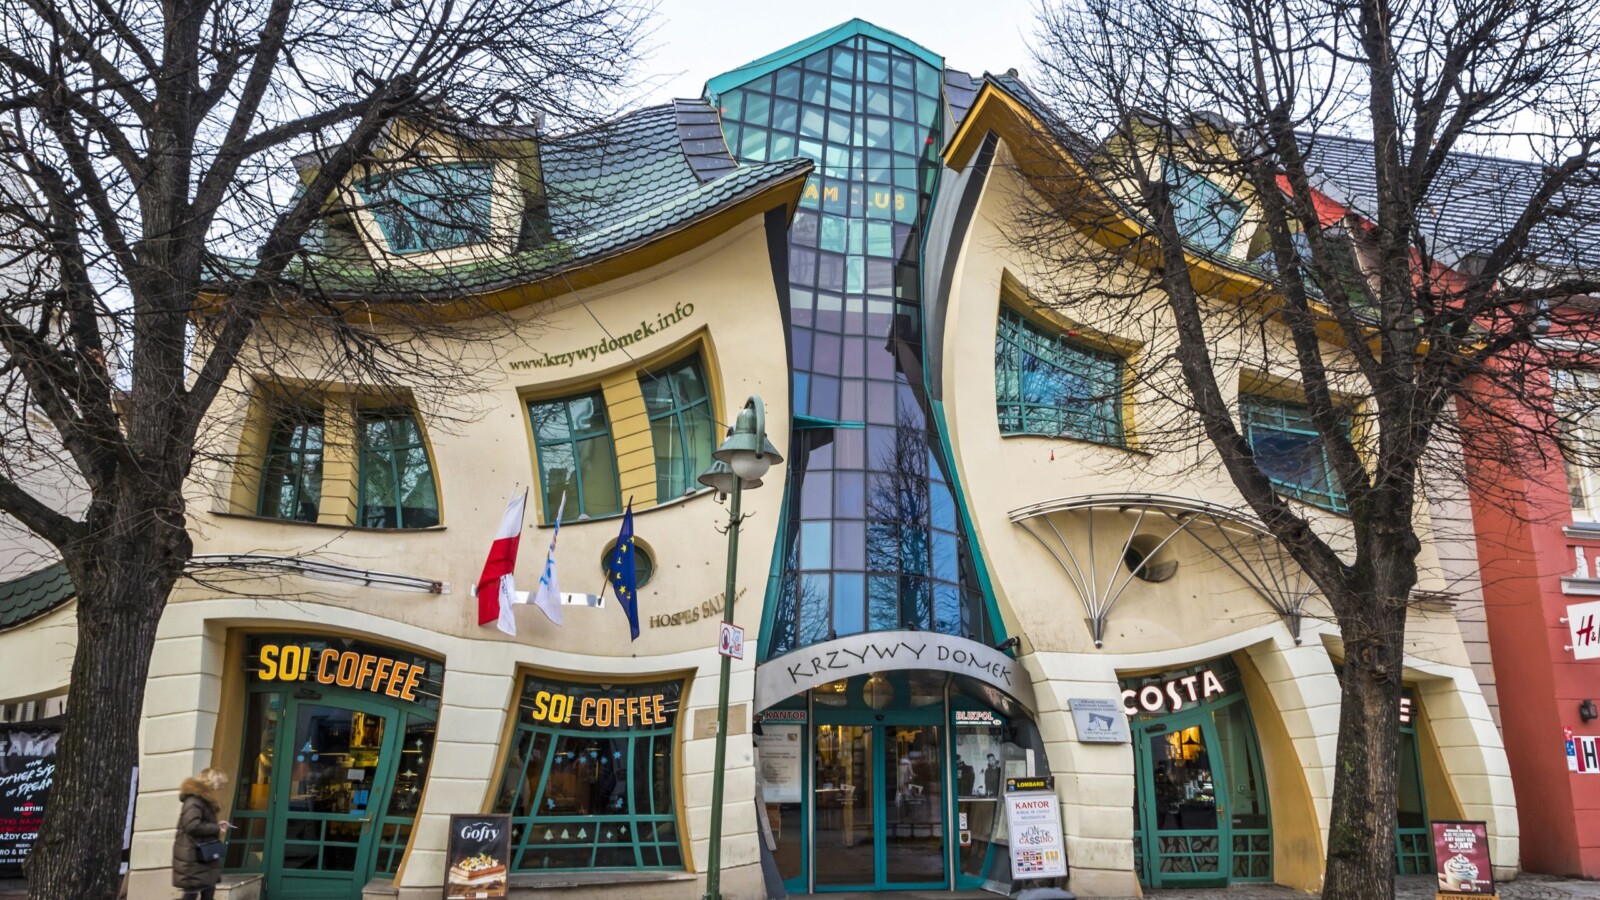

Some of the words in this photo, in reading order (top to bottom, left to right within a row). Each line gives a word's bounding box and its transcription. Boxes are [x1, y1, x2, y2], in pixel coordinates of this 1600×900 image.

[851, 188, 905, 211] UB
[509, 301, 694, 371] www.krzywydomek.info
[650, 606, 699, 629] HOSPES
[1576, 614, 1600, 646] H&
[258, 645, 312, 681] SO!
[317, 648, 425, 702] COFFEE
[787, 642, 927, 684] KRZYWY
[938, 646, 1012, 686] DOMEK
[532, 691, 575, 724] SO!
[580, 694, 667, 727] COFFEE
[1121, 670, 1224, 716] COSTA
[765, 711, 806, 720] KANTOR
[1015, 801, 1050, 809] KANTOR
[461, 825, 499, 843] Gofry
